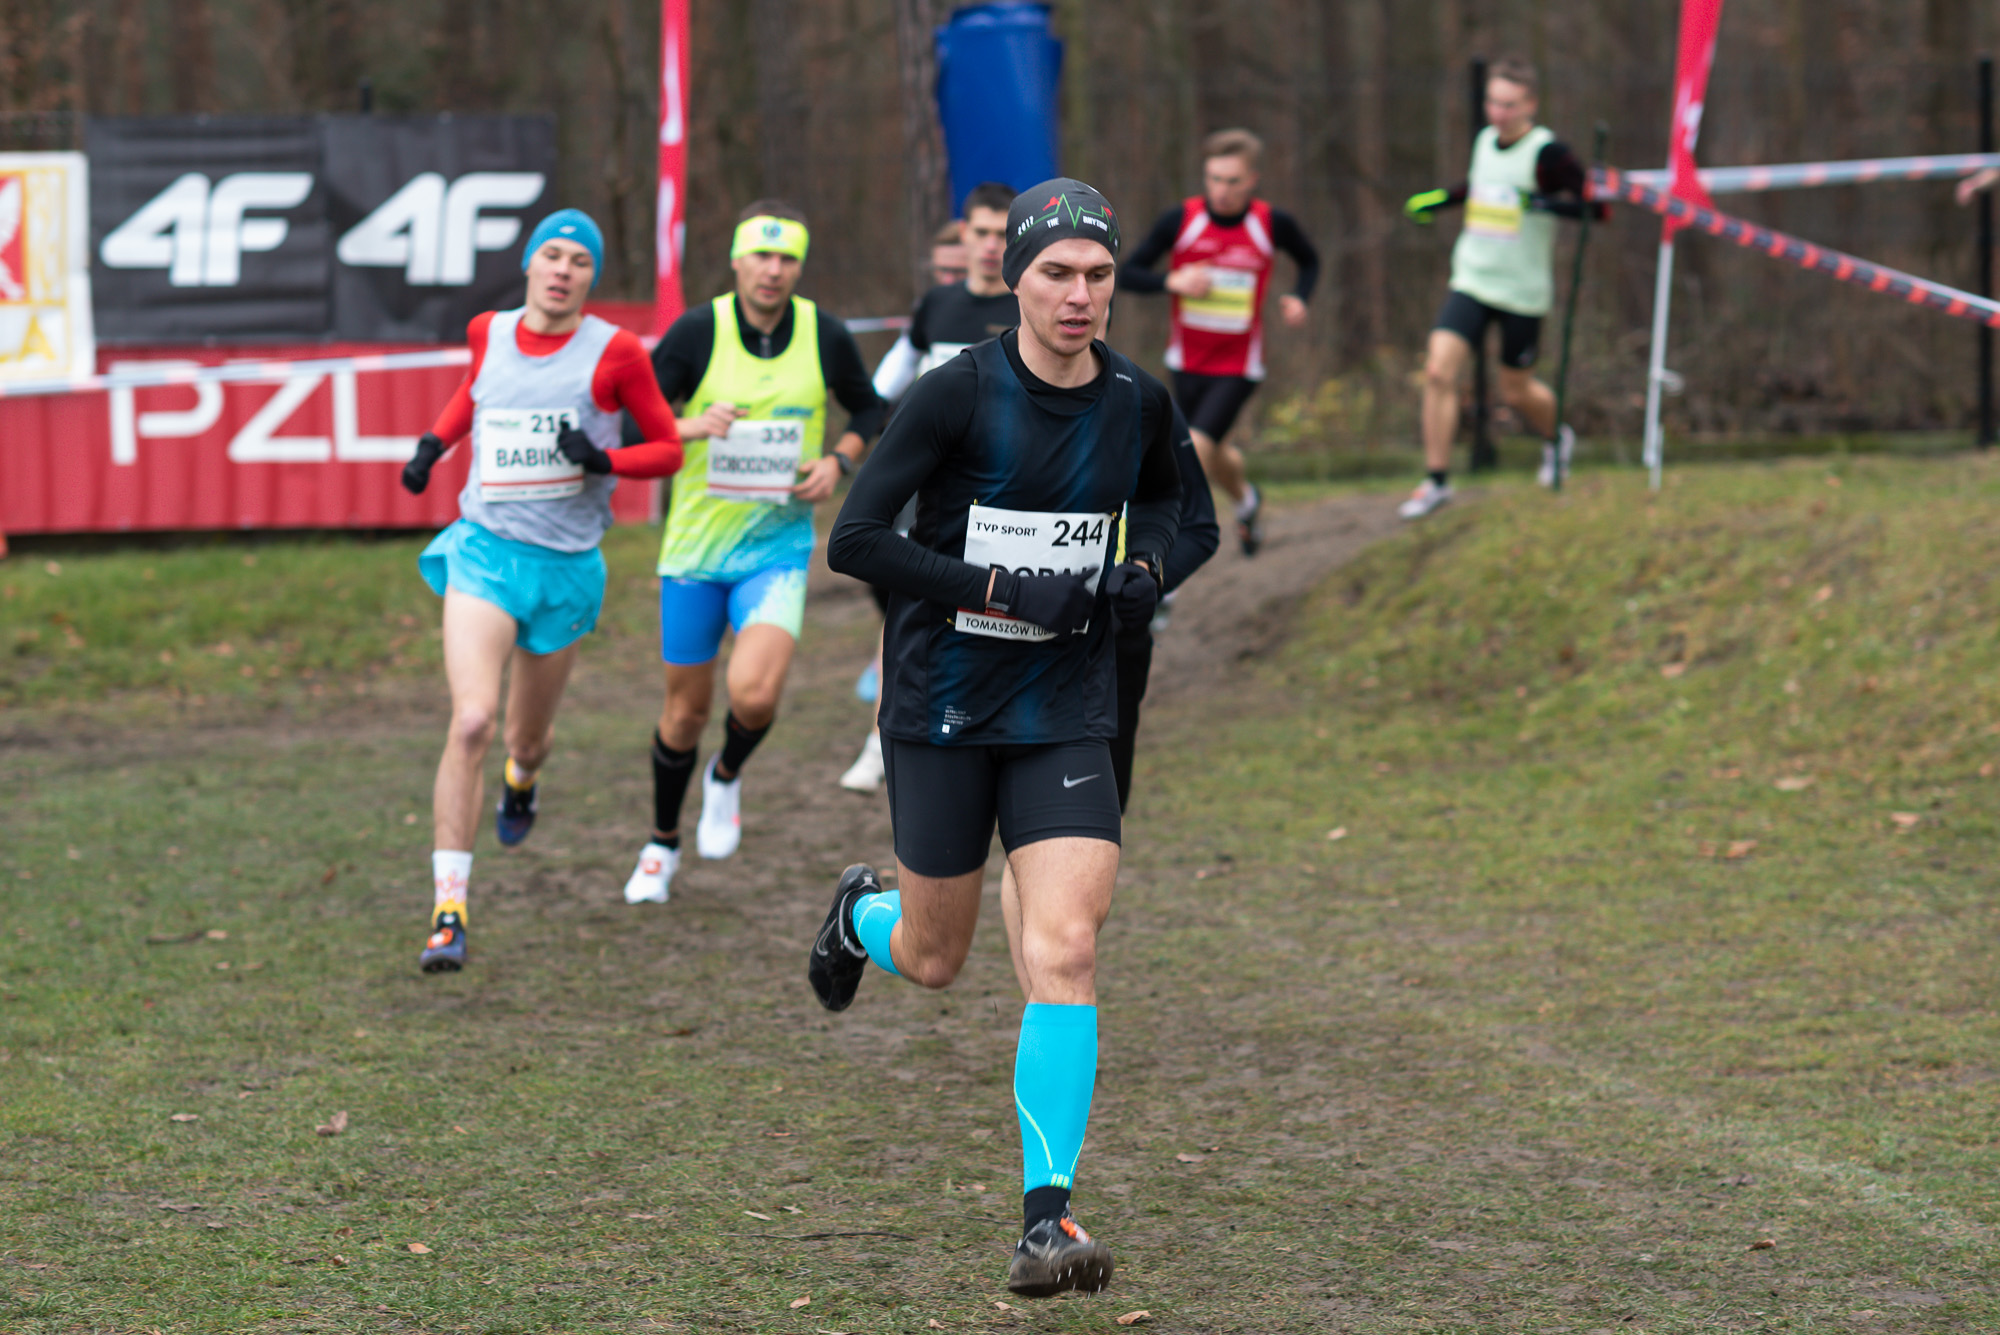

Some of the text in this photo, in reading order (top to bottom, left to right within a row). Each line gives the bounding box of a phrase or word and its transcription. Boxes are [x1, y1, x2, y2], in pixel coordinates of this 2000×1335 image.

[100, 171, 314, 286] 4F
[336, 171, 545, 286] 4F
[110, 360, 460, 466] PZL
[762, 426, 800, 444] 336
[976, 521, 1038, 537] TVP SPORT
[1052, 519, 1104, 547] 244
[965, 617, 1030, 636] TOMASZÓW
